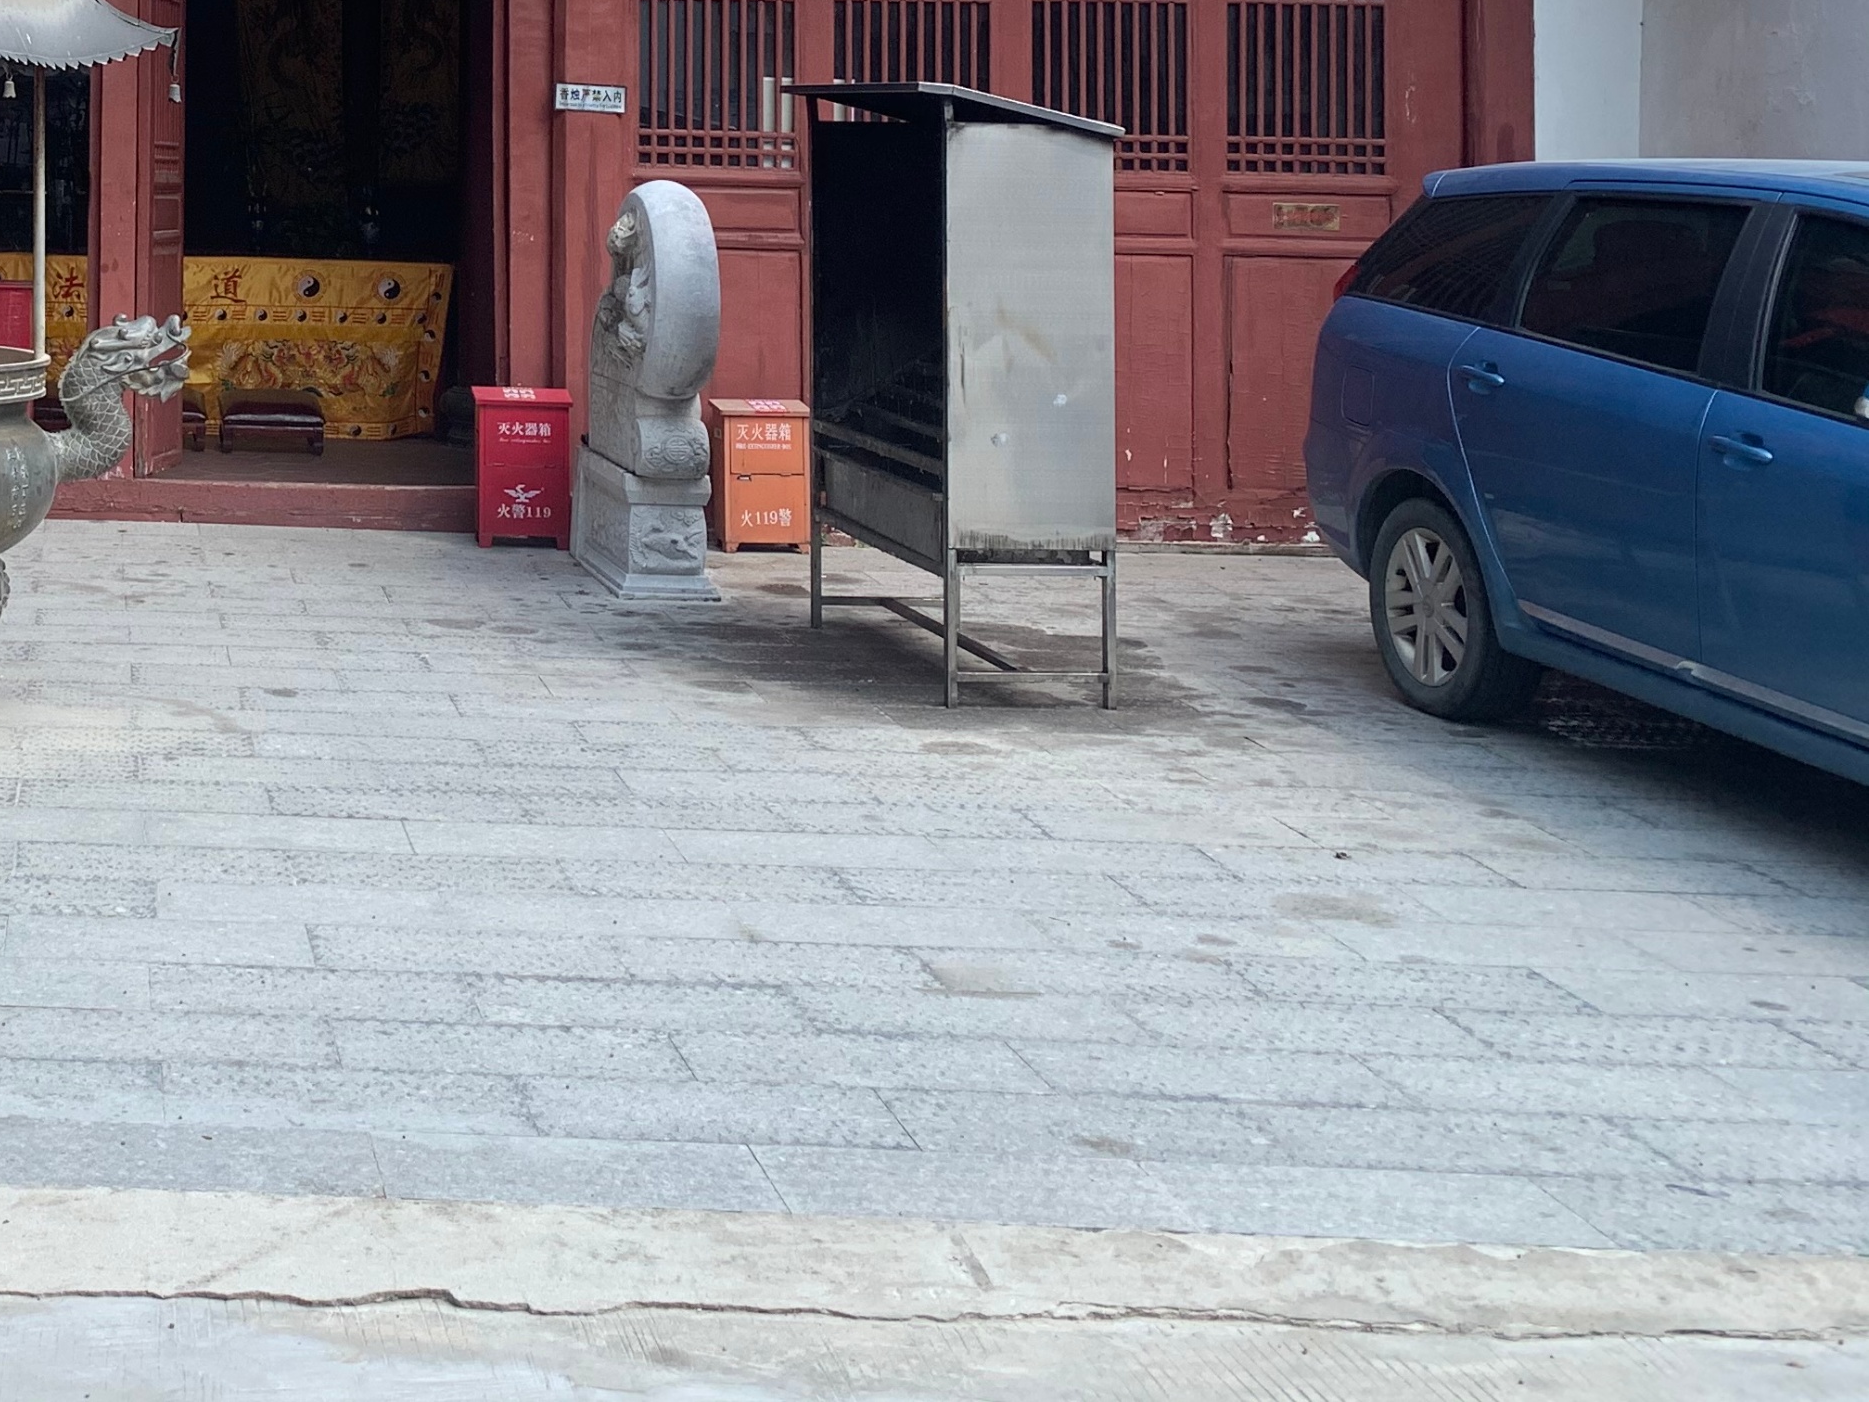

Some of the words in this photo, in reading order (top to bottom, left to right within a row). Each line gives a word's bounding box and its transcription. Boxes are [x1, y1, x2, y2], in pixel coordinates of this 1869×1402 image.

[559, 87, 622, 104] 香烛严禁入内
[497, 421, 551, 436] 灭火器箱
[736, 422, 792, 441] 灭火器箱
[497, 503, 552, 519] 火警119
